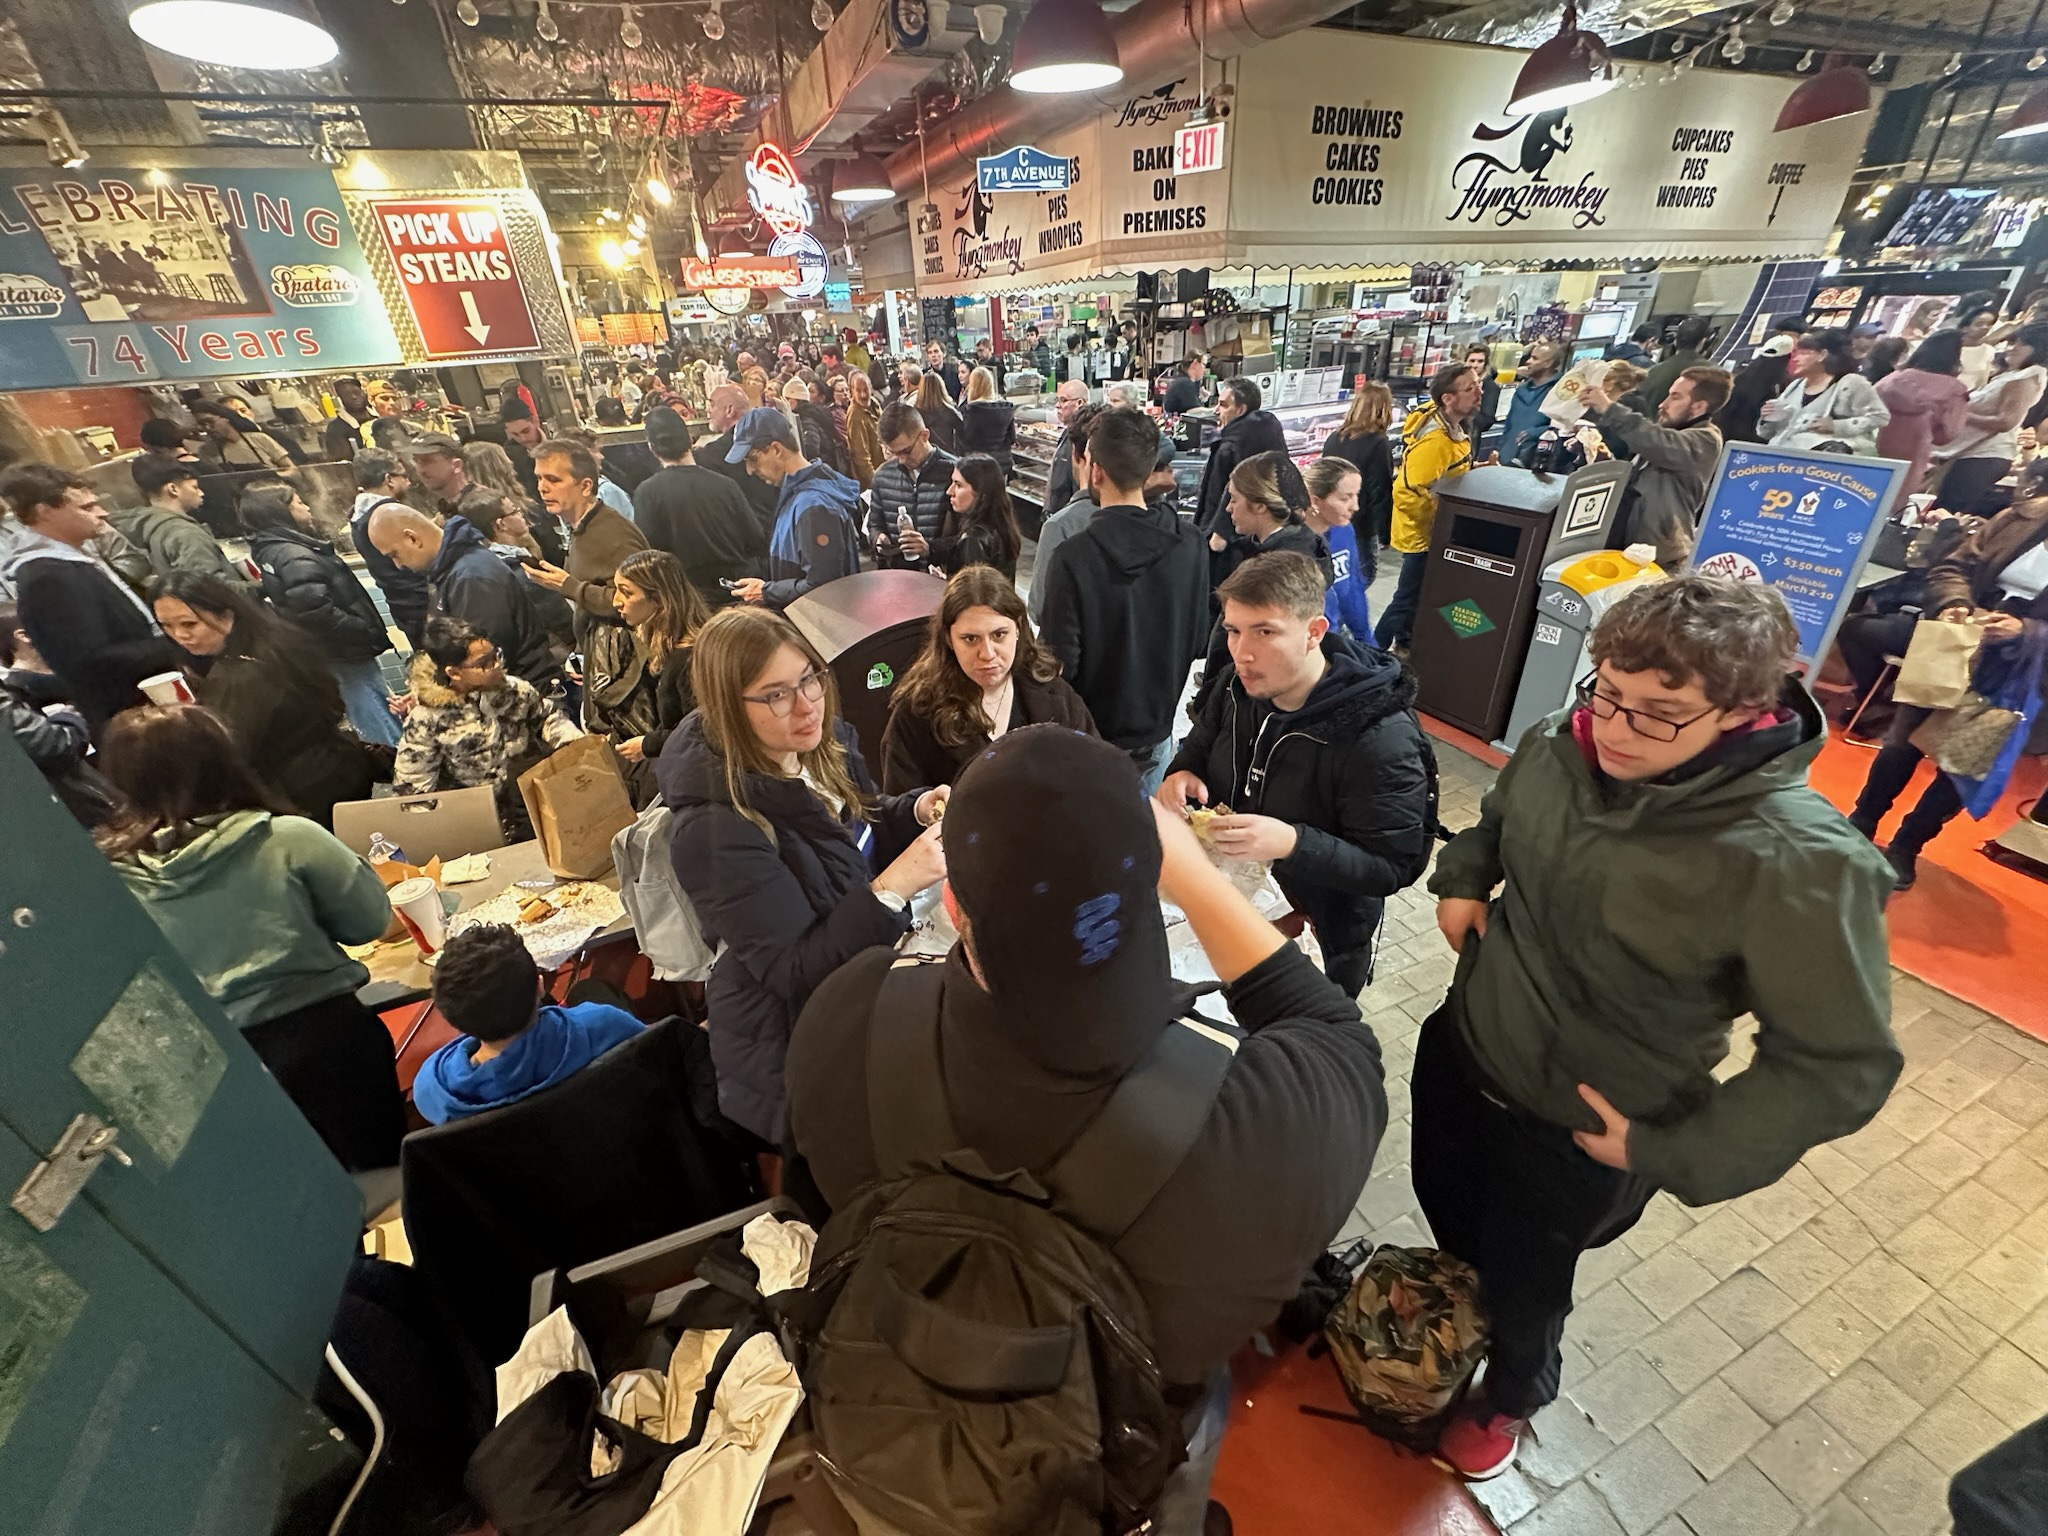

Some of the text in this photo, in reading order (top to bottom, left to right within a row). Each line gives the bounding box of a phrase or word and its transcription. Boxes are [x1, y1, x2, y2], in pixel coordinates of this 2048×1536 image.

[1311, 105, 1404, 139] BROWNIES
[1182, 127, 1218, 170] EXIT
[1672, 127, 1734, 153] CUPCAKES
[1018, 148, 1029, 167] C
[1133, 145, 1174, 172] BAKI
[1326, 142, 1380, 172] CAKES
[1680, 157, 1708, 180] PIES
[983, 167, 1008, 187] 7TH
[1010, 165, 1066, 180] AVENUE
[1767, 162, 1807, 184] COFFEE
[1153, 177, 1177, 202] ON
[1312, 177, 1384, 206] COOKIES
[1656, 185, 1718, 208] WHOOPIES
[1047, 193, 1068, 222] PIES
[1123, 205, 1206, 234] PREMISES
[383, 211, 498, 246] PICK UP
[1038, 220, 1083, 254] WHOOPIES
[400, 250, 512, 285] STEAKS
[67, 324, 321, 378] 74 Years
[1728, 464, 1775, 479] Cookies
[1777, 463, 1794, 473] for
[1805, 465, 1841, 481] Good
[1841, 475, 1877, 500] Cause
[1761, 488, 1793, 511] 50
[1756, 510, 1785, 520] years
[1473, 557, 1492, 569] TRASH
[1783, 557, 1843, 577] $3.50 each
[1774, 579, 1834, 600] March 2-10
[1786, 574, 1828, 589] Available
[1451, 610, 1482, 625] TERMINAL
[1453, 617, 1478, 629] MARKET
[1454, 606, 1481, 619] READING
